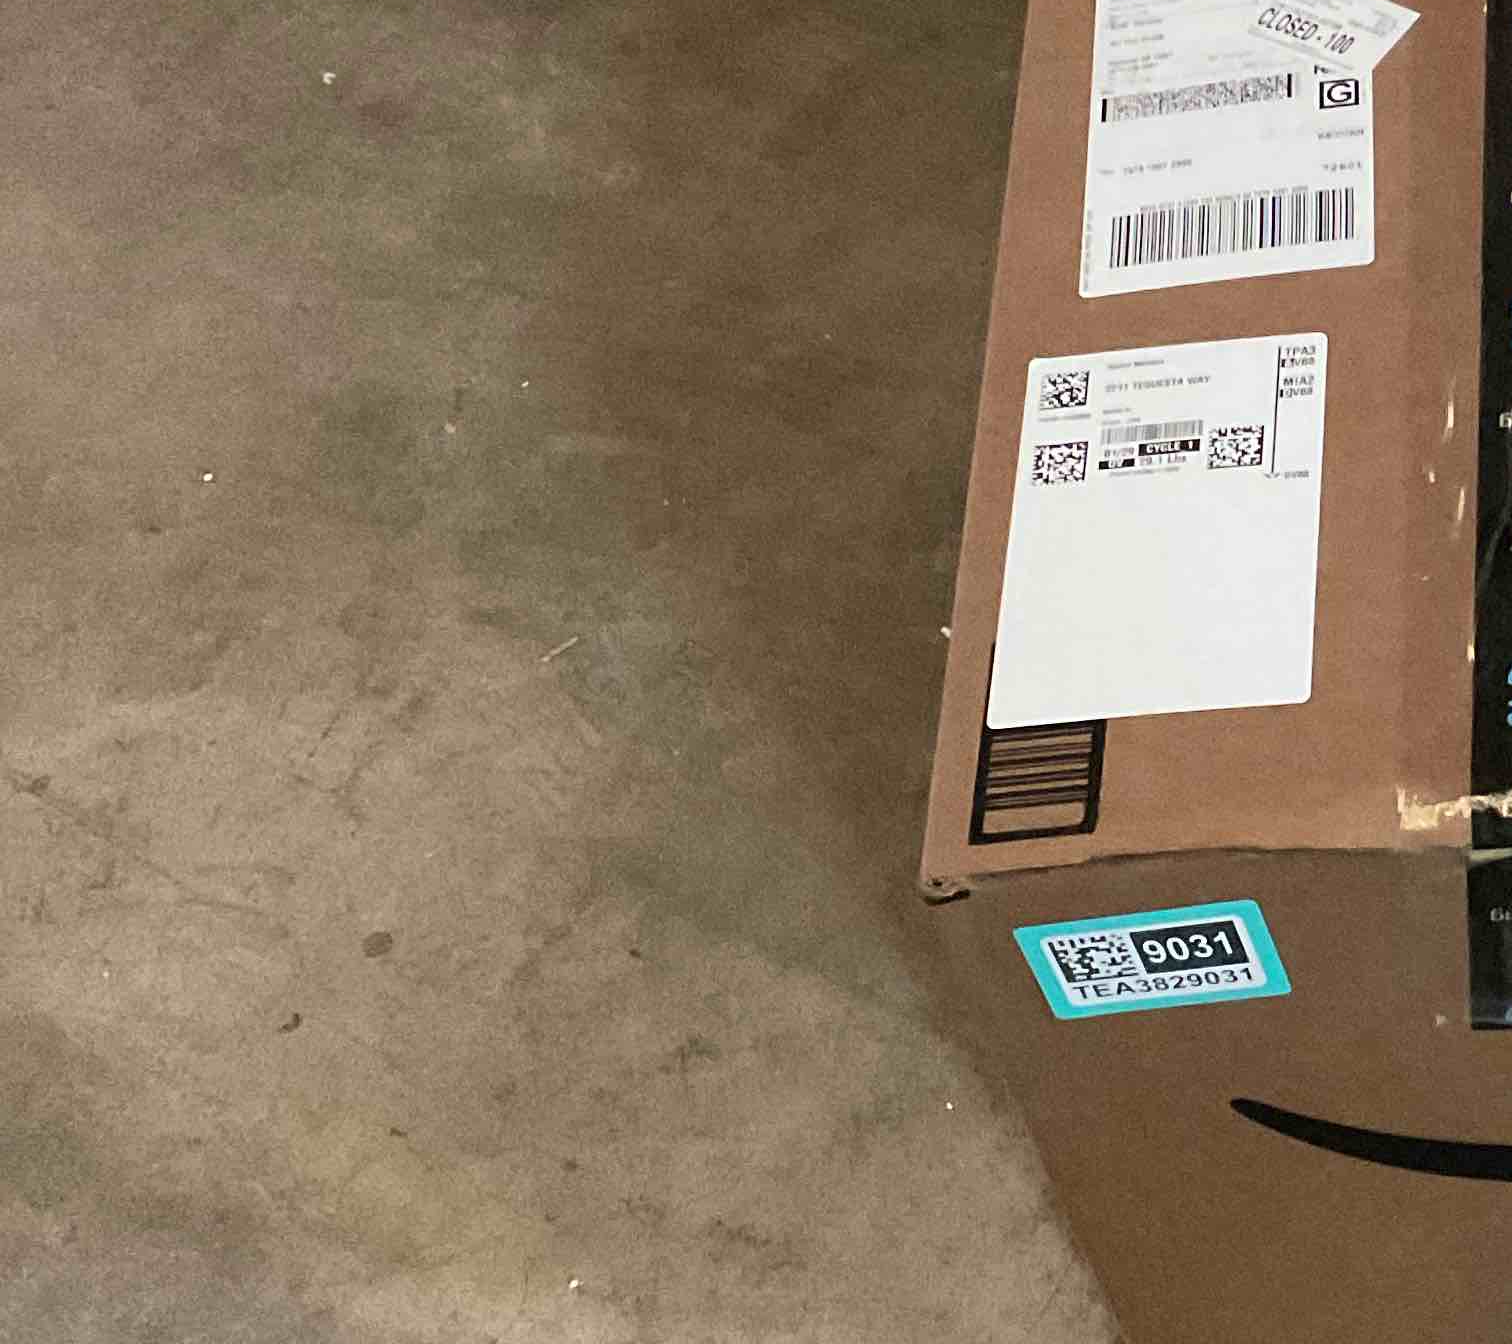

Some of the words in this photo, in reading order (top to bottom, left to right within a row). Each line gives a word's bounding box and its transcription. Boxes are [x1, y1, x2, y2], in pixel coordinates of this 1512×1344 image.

[1258, 7, 1319, 41] CLOSED
[1324, 31, 1356, 55] 100
[1326, 83, 1352, 104] G
[1146, 441, 1181, 454] CYCLE
[1142, 931, 1235, 964] 9031
[1072, 967, 1253, 1000] TEA3829031
